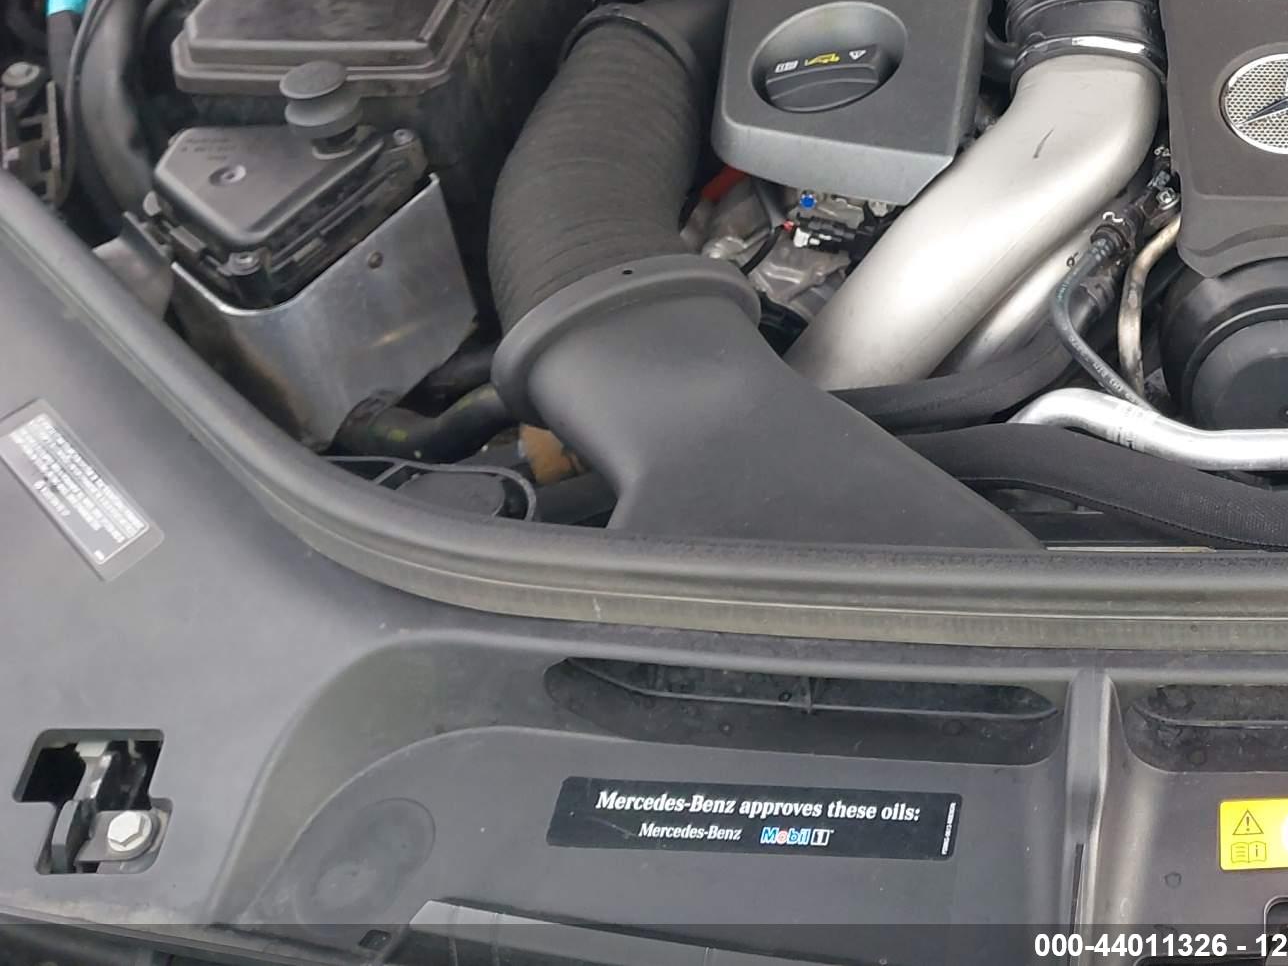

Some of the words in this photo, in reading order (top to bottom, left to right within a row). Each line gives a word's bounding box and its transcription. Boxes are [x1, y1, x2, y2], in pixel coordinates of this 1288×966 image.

[595, 791, 736, 814] Mercedes-Benz
[739, 800, 822, 819] approves
[827, 800, 877, 820] these
[881, 802, 920, 822] oils:
[638, 822, 743, 841] Mercedes-Benz
[759, 827, 811, 845] Mobil
